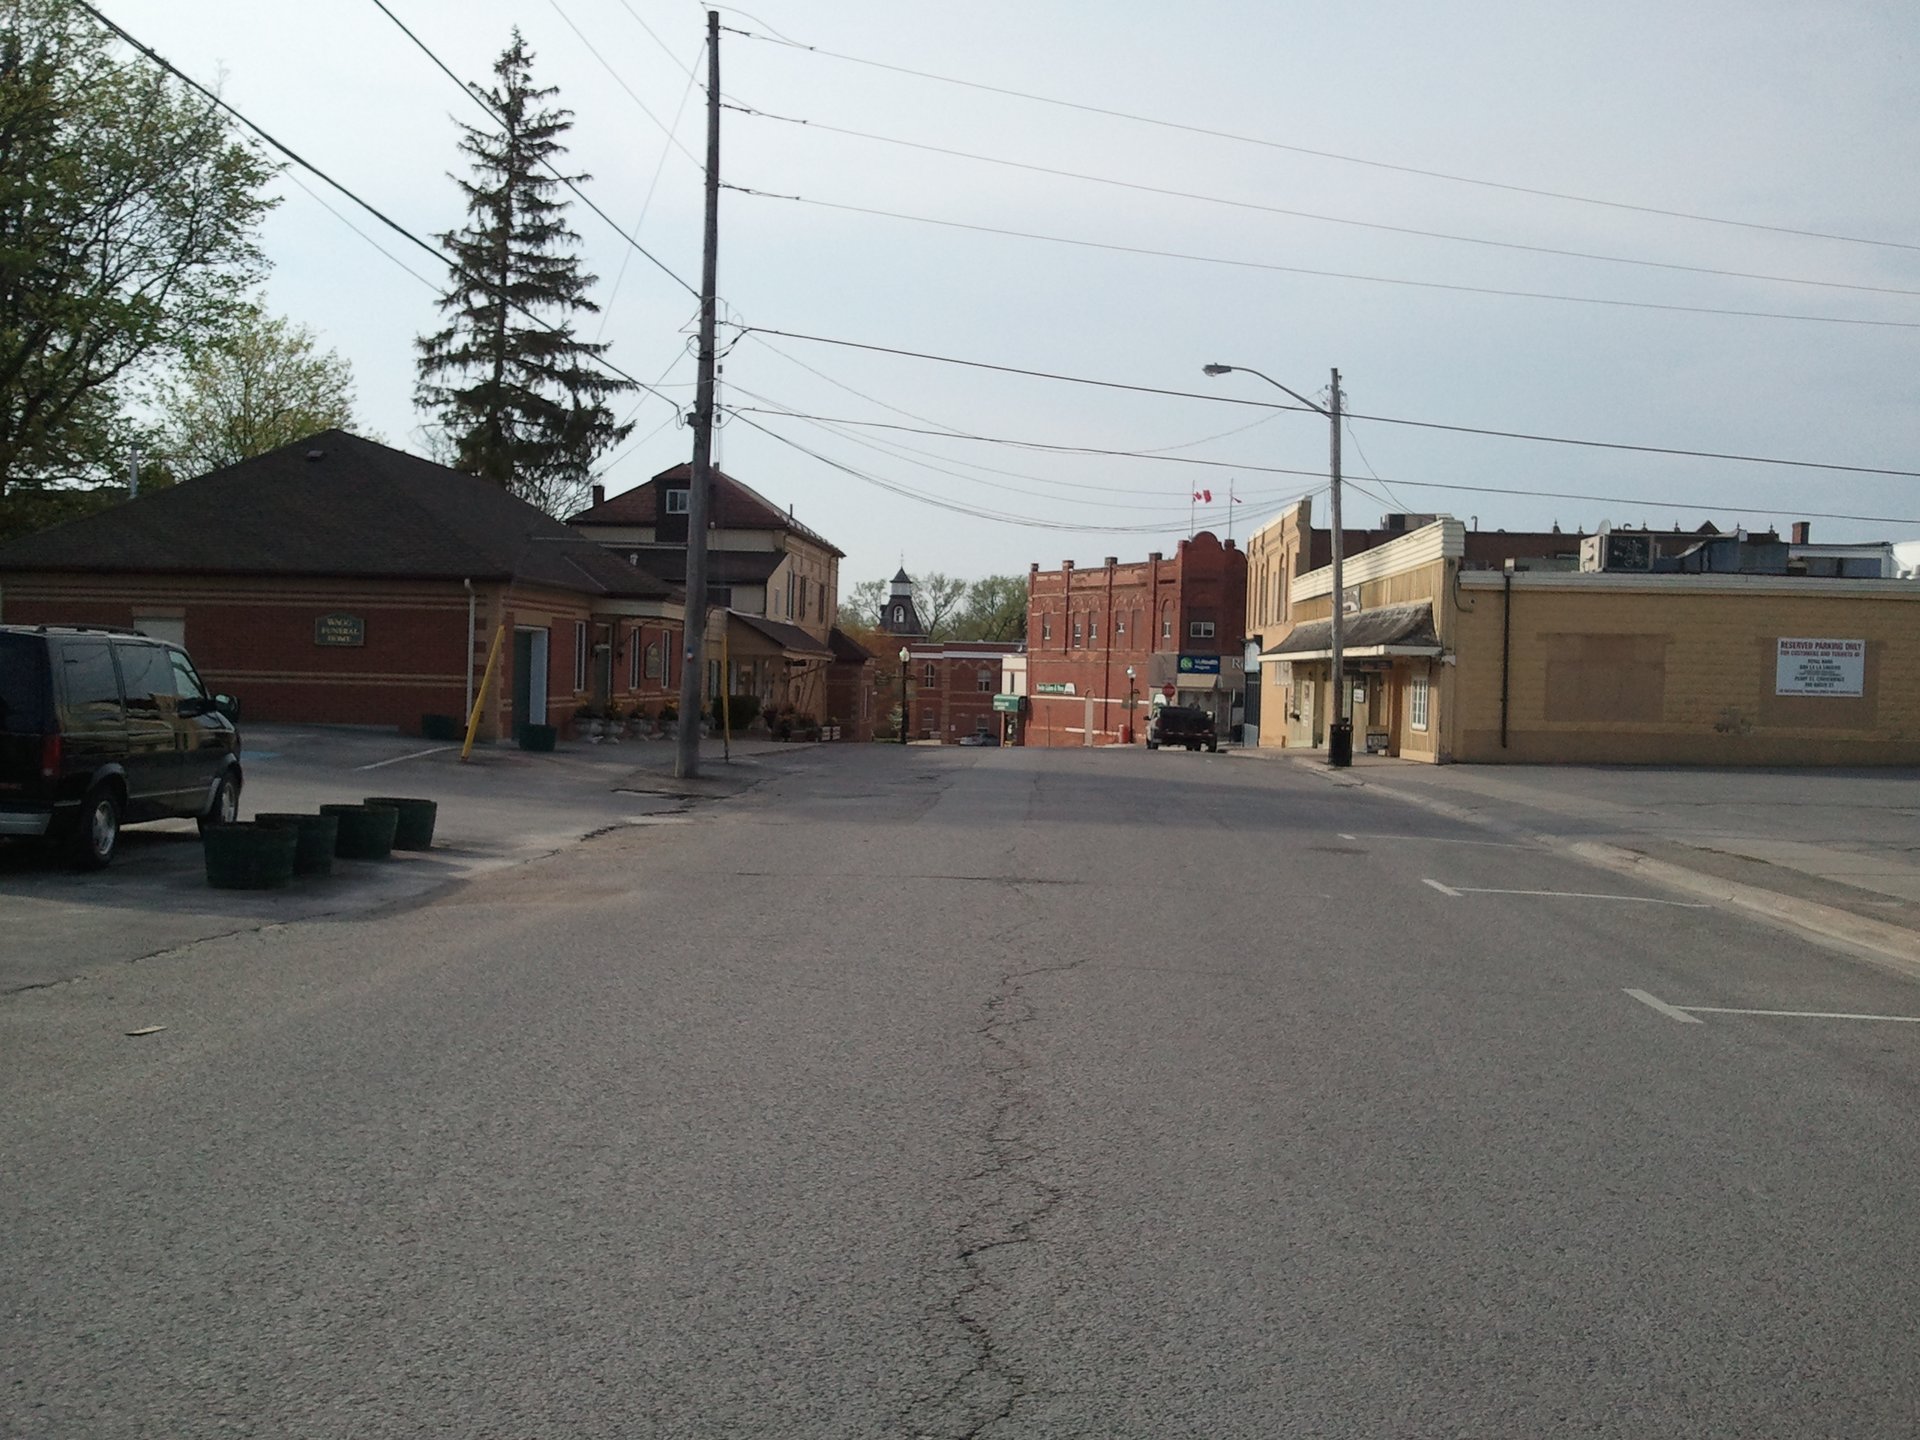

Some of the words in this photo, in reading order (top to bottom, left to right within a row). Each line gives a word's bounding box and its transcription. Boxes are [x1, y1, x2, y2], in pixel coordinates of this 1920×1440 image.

[1780, 641, 1813, 649] RESERVED
[1815, 642, 1843, 650] PARKING
[1845, 642, 1862, 651] ONLY
